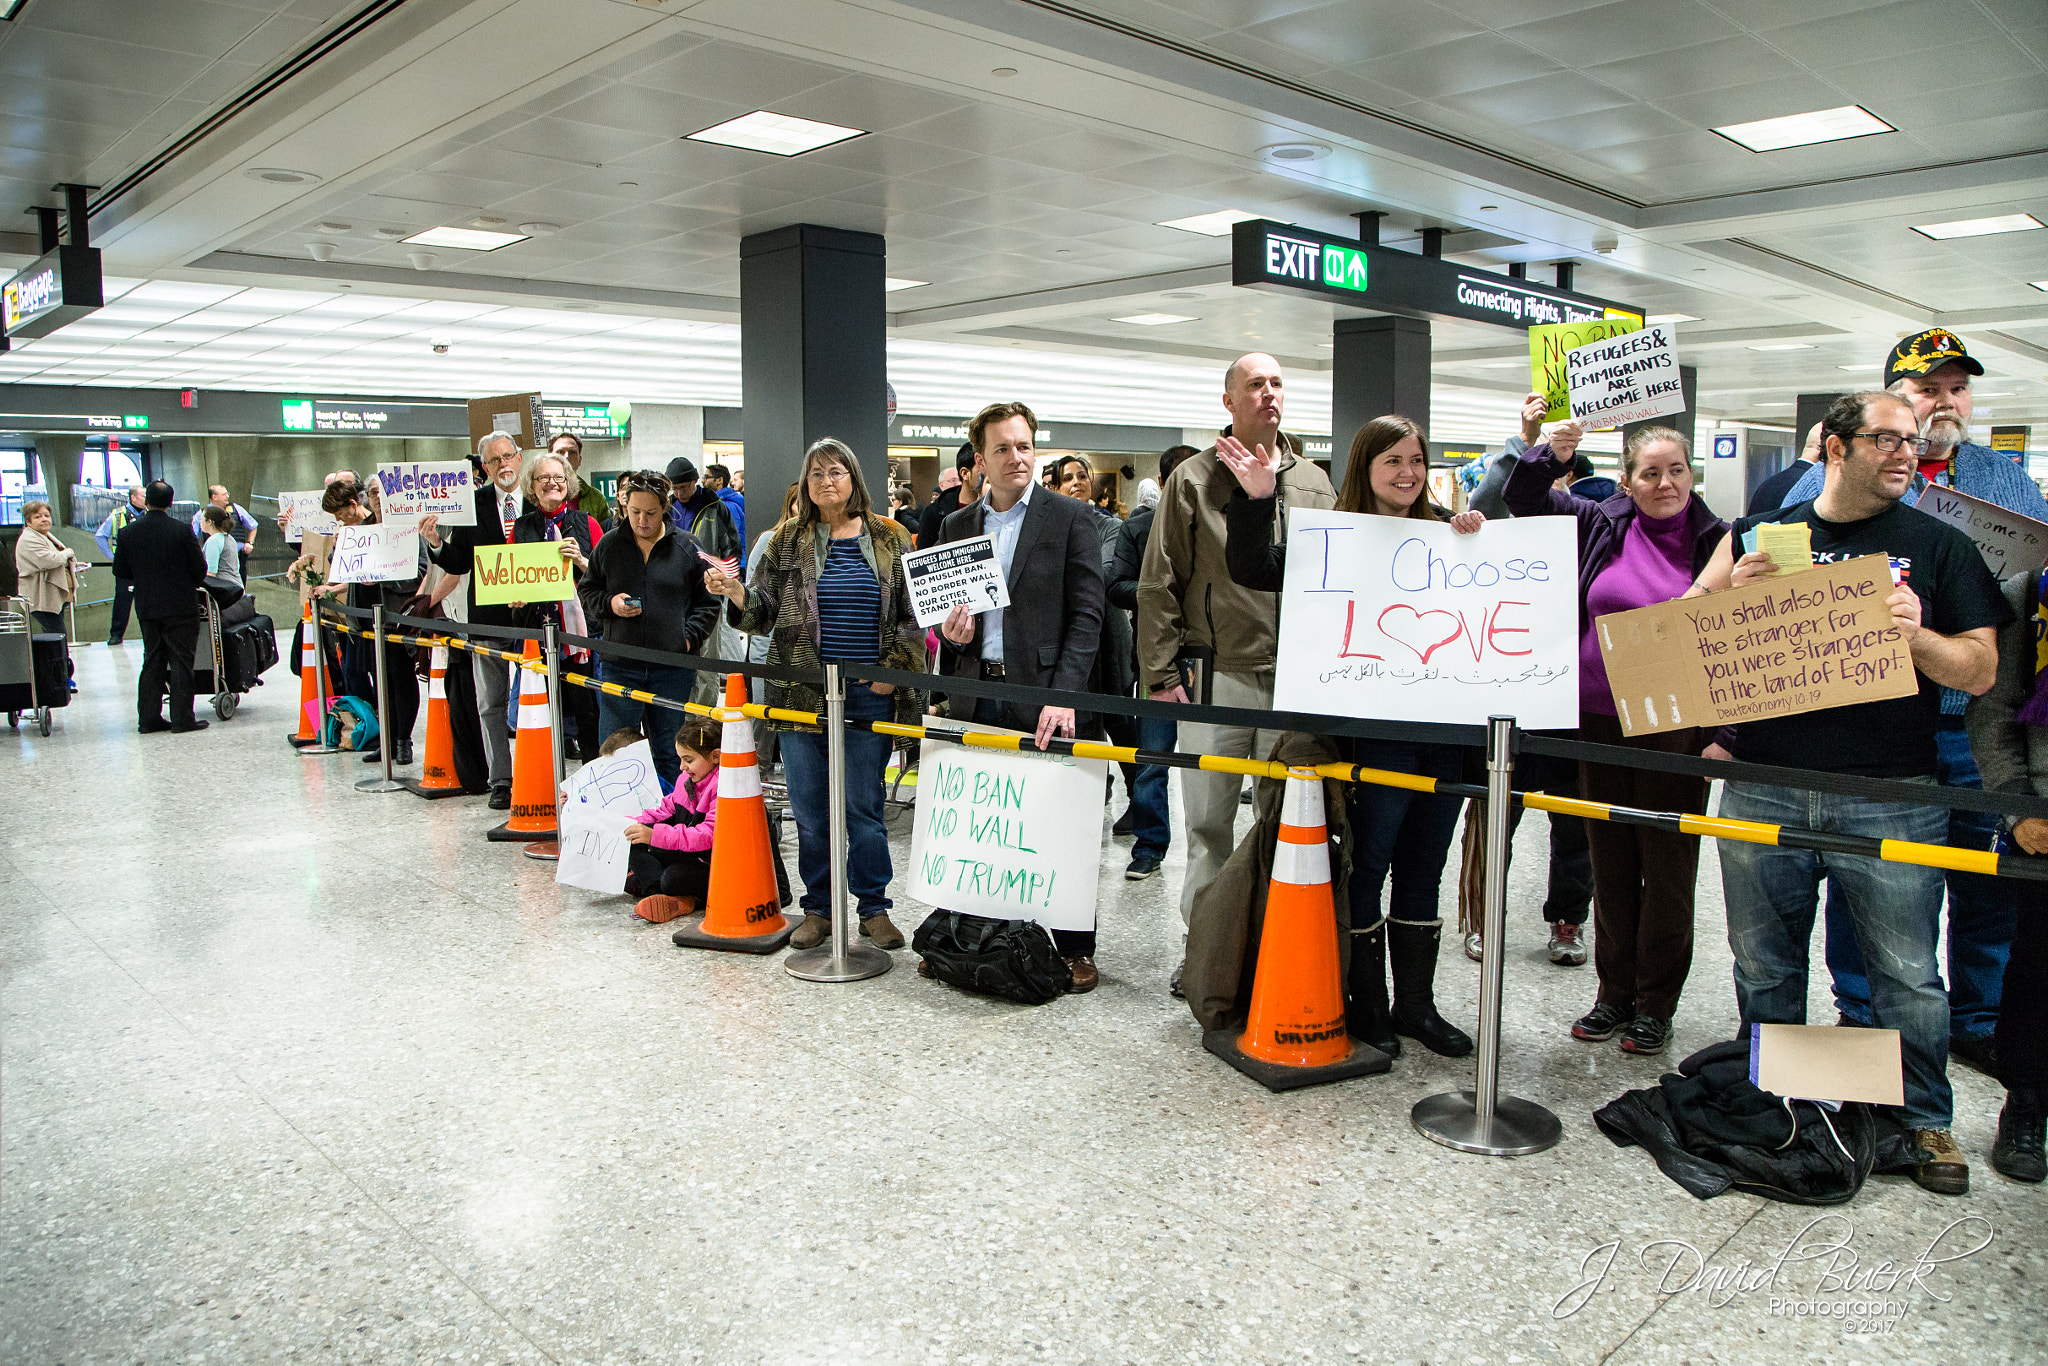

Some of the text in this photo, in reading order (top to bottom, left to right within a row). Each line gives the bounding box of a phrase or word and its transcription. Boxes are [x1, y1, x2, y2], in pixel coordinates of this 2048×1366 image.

[1267, 239, 1320, 281] EXIT
[18, 268, 54, 313] Baggage
[1457, 282, 1603, 324] Connecting Flights, Transf
[1569, 352, 1672, 391] IMMIGRANTS
[1607, 375, 1638, 392] ARE
[1571, 378, 1681, 418] WELCOME HERE
[87, 417, 122, 428] Parking
[365, 421, 381, 429] Van
[902, 425, 969, 439] STARBUC
[377, 464, 468, 497] Welcome
[405, 490, 414, 501] to
[416, 489, 430, 500] the
[431, 487, 450, 499] U.S.
[389, 504, 414, 513] Nation
[415, 502, 422, 512] of
[424, 502, 462, 514] Immigrants
[1936, 497, 2039, 545] Welcome to
[342, 526, 380, 550] Ban
[1973, 539, 2005, 558] rica
[476, 552, 571, 586] Welcome!
[908, 541, 991, 570] REFUGEES AND IMMIGRANTS
[926, 555, 975, 573] WELCOME HERE.
[1298, 527, 1550, 593] I Choose
[913, 563, 987, 588] NO MUSLIM BAN.
[915, 572, 998, 598] NO BORDER WALL.
[918, 589, 968, 608] OUR CITIES
[920, 596, 977, 616] STAND TALL.
[1685, 579, 1878, 635] You shall also love
[1697, 609, 1865, 658] the stranger, for
[1703, 625, 1902, 687] you were strangers
[1709, 648, 1906, 705] in the land of Egypt.
[1716, 694, 1792, 721] Deuteronomy
[933, 761, 1026, 811] NO BAN
[511, 803, 557, 818] GROUNDS
[927, 805, 1038, 854] NO WALL
[920, 850, 1057, 908] NO TRUMP!
